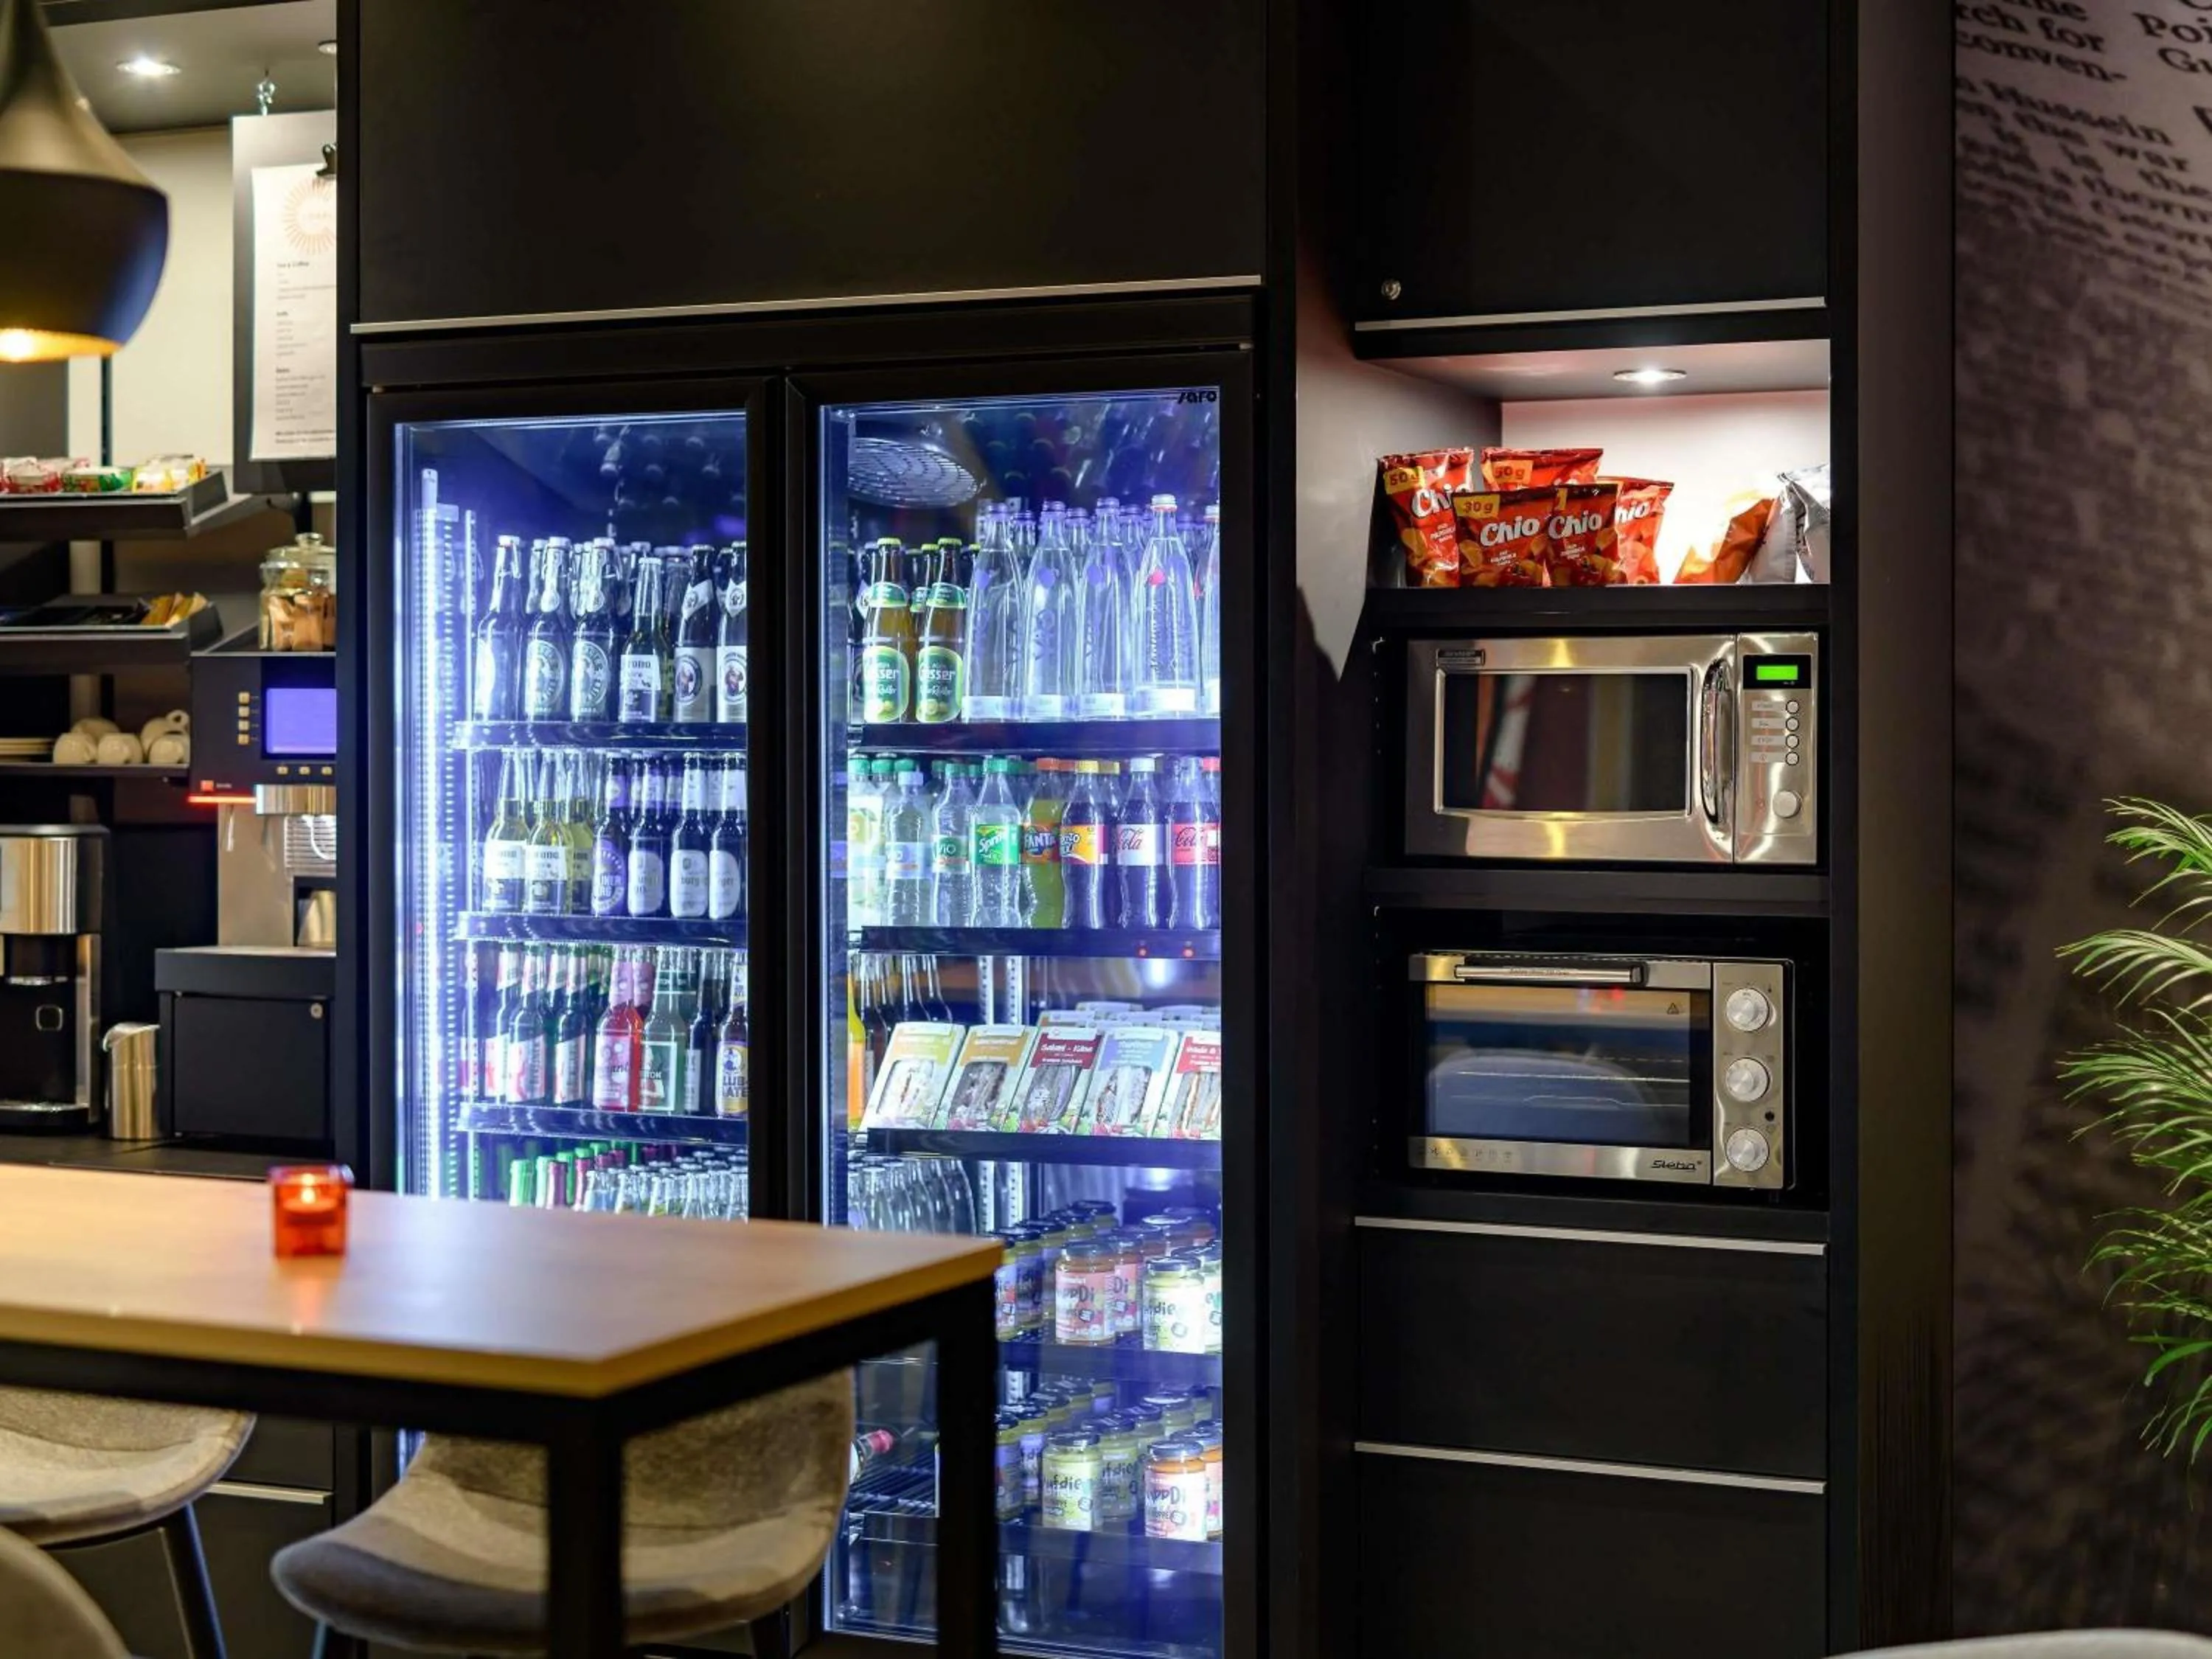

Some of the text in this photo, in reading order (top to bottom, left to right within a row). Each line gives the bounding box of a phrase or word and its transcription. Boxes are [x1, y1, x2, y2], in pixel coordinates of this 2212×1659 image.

[2037, 16, 2105, 52] for
[1480, 515, 1541, 547] Chio
[1548, 509, 1602, 540] Chio
